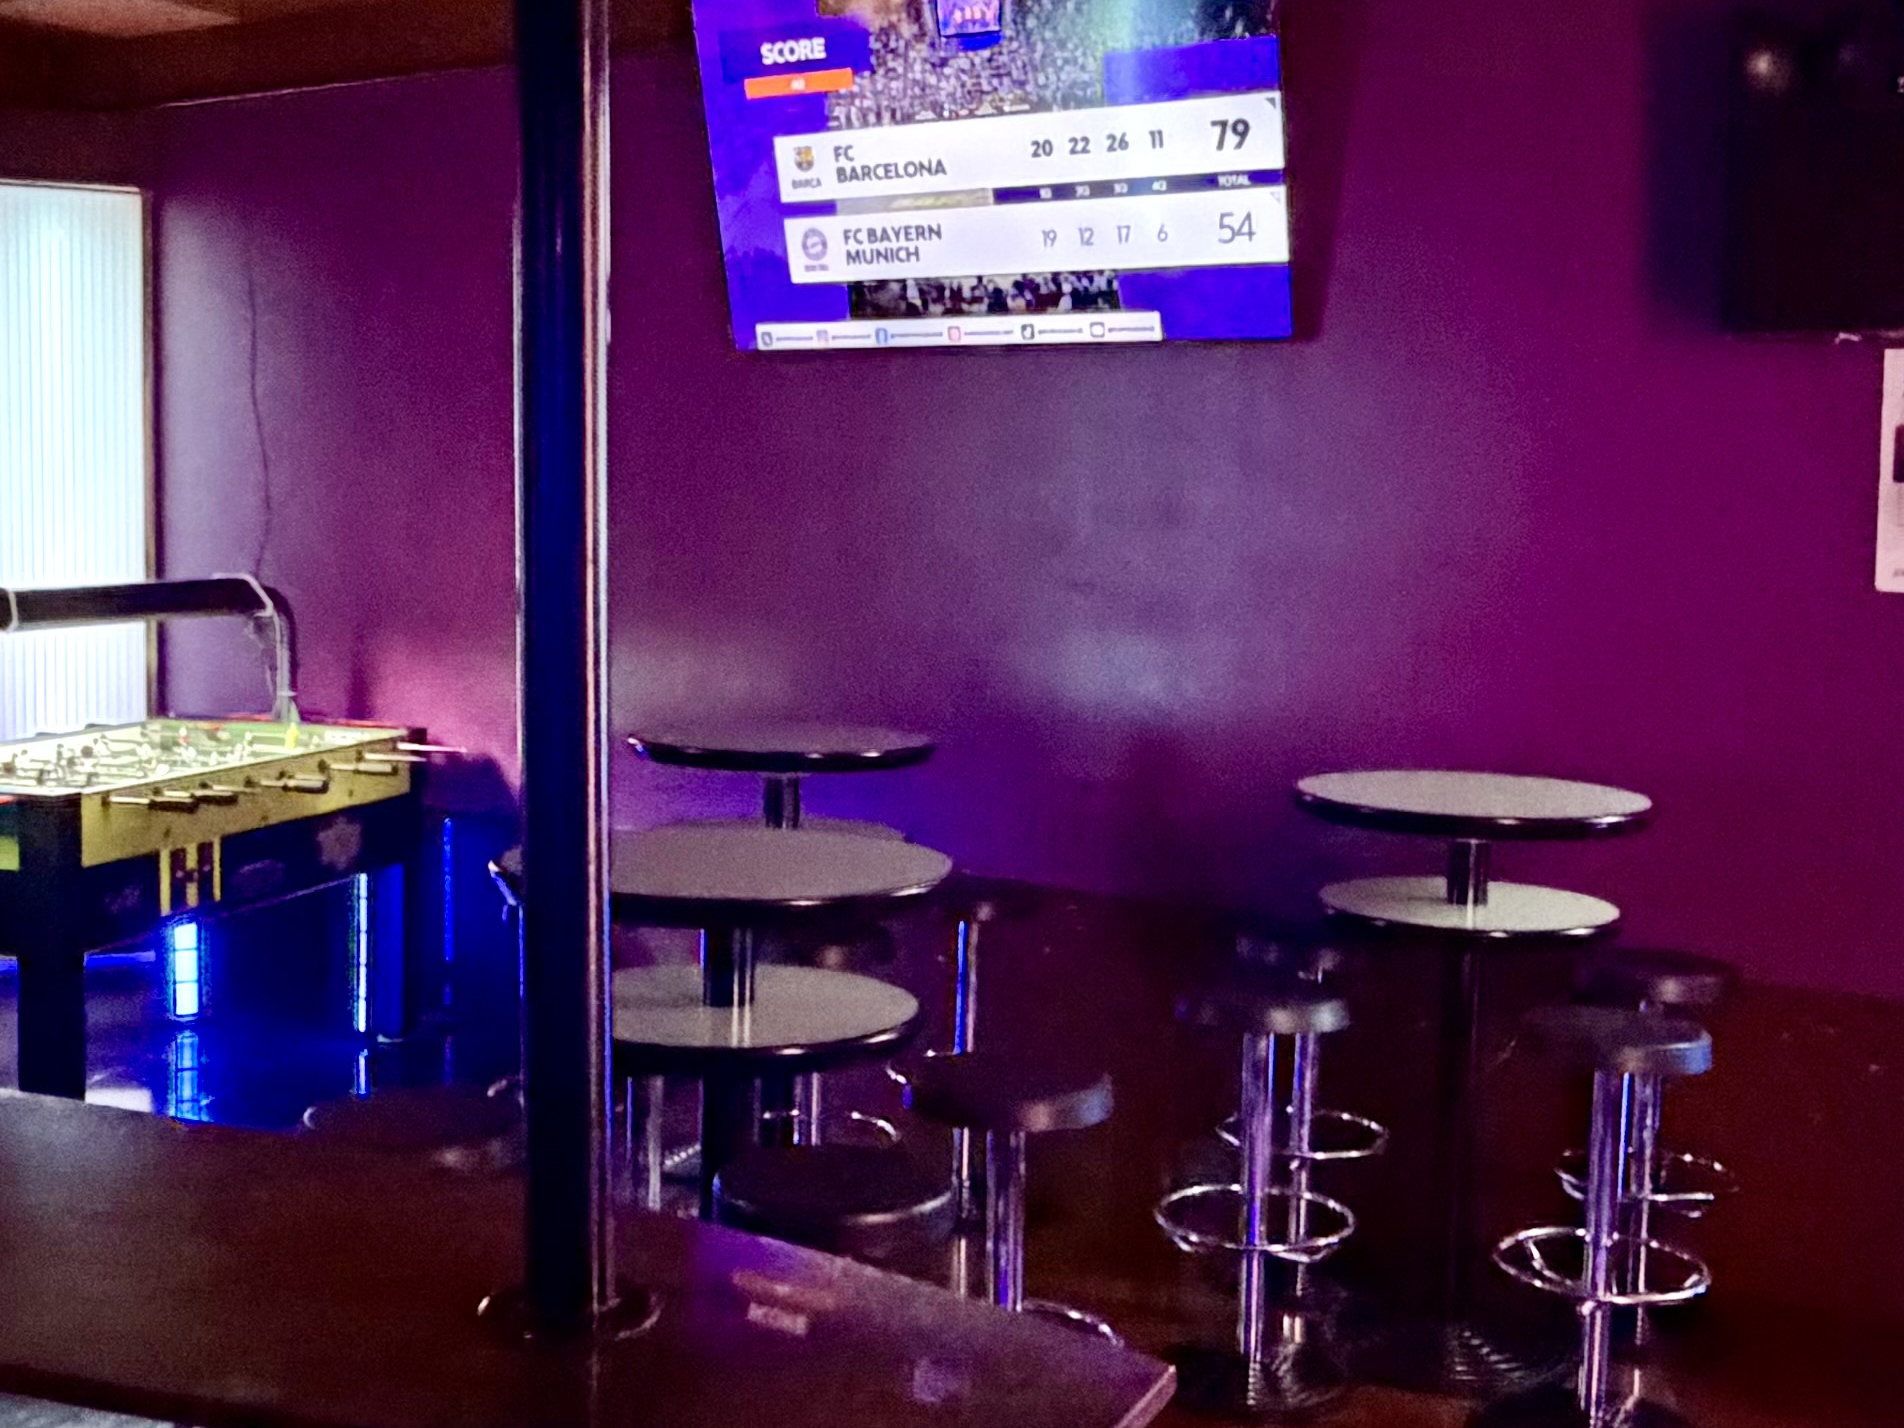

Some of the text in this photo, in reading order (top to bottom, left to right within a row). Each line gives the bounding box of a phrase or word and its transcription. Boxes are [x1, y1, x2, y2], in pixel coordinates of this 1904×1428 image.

[760, 37, 827, 66] SCORE
[1031, 130, 1165, 159] 20 22 26 11
[1210, 119, 1251, 152] 79
[833, 144, 855, 163] FC
[836, 158, 948, 183] BARCELONA
[1217, 175, 1251, 187] TOTAL
[843, 223, 943, 245] FC BAYERN
[1041, 224, 1169, 248] 19 12 17 6
[1217, 212, 1256, 245] 54
[846, 246, 921, 266] MUNICH
